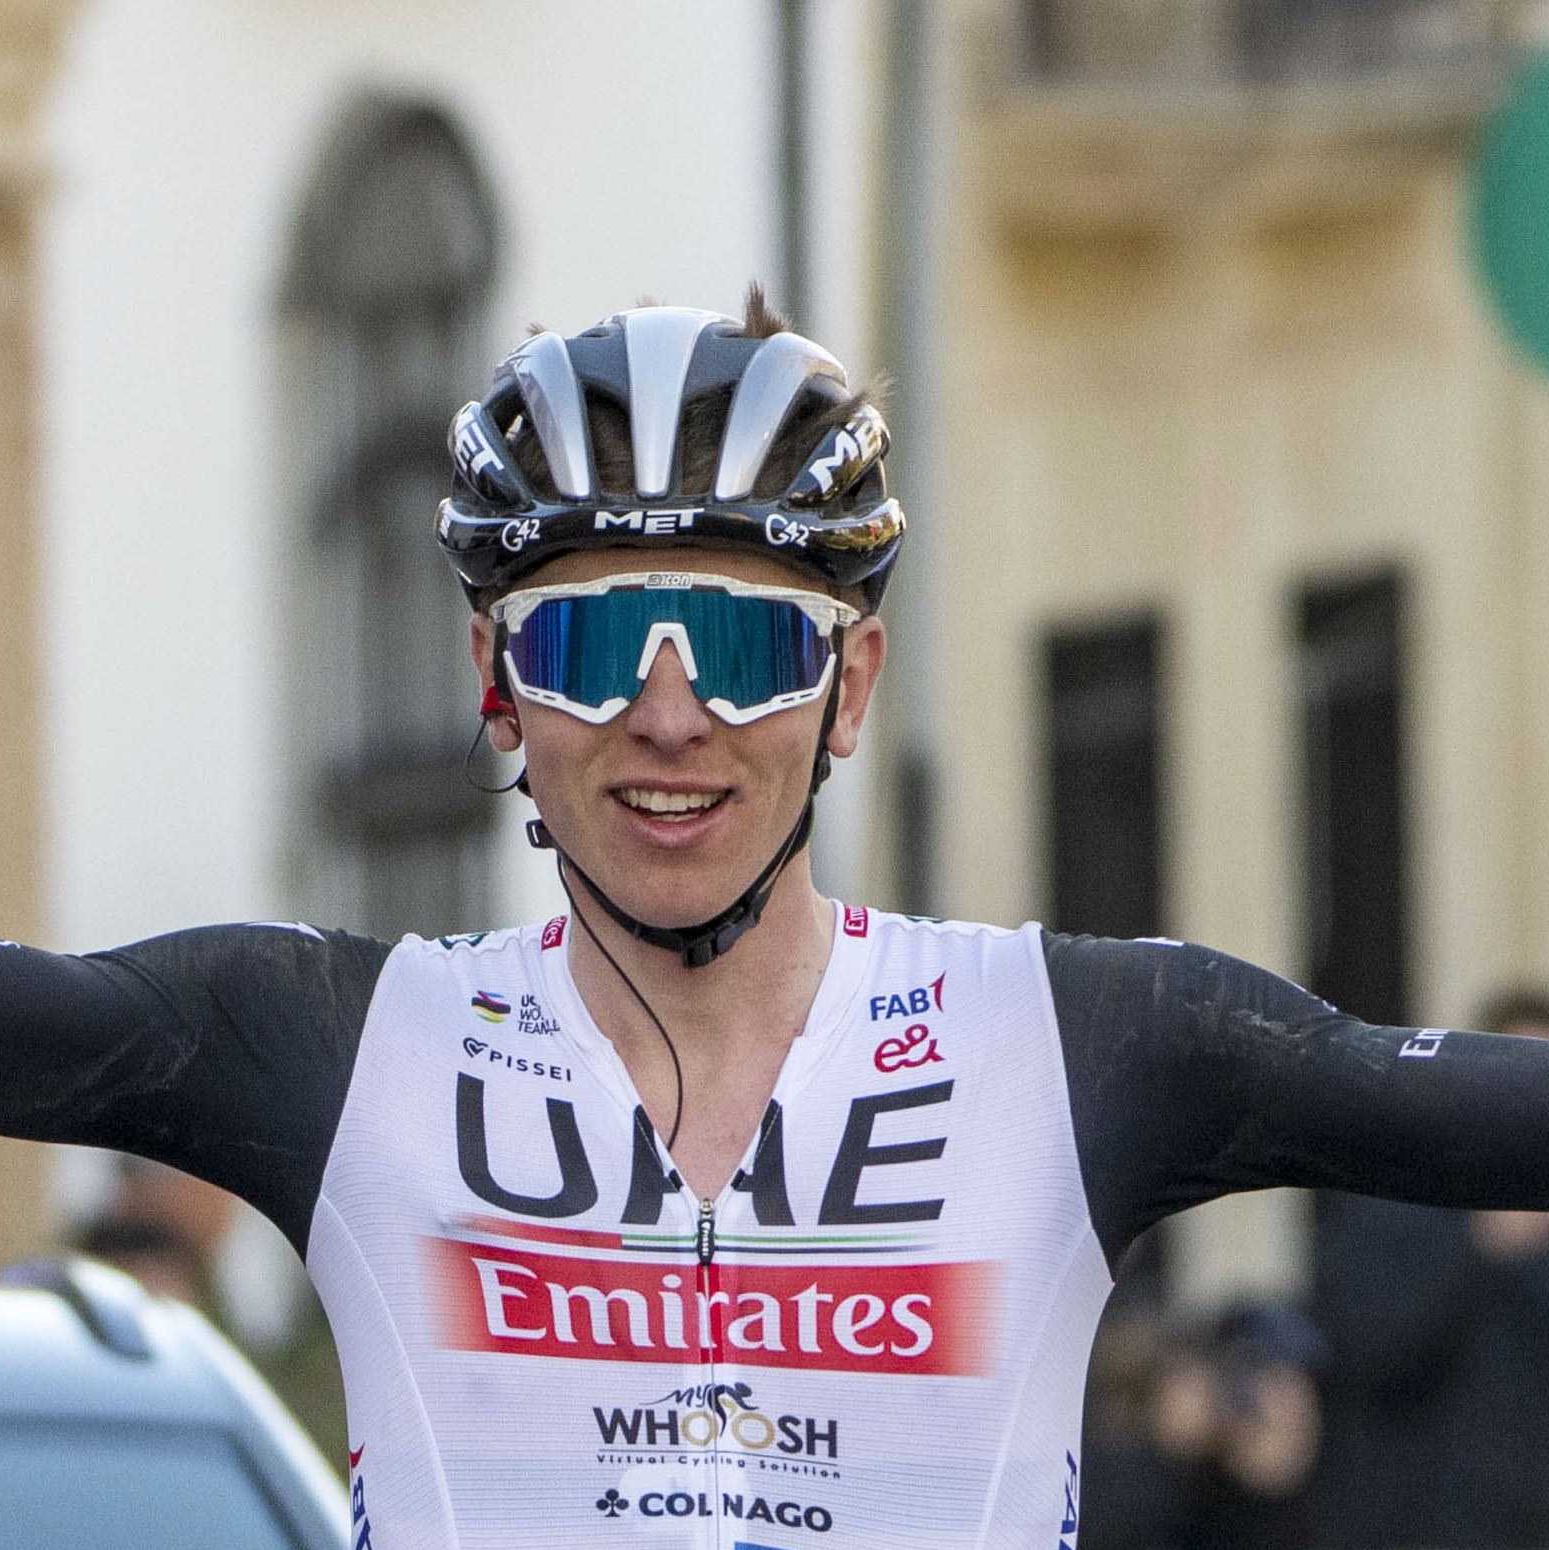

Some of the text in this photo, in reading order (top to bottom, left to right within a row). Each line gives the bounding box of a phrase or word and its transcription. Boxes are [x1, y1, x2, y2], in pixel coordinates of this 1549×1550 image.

[502, 519, 540, 553] G42
[594, 508, 705, 536] MET
[765, 513, 811, 548] G42
[870, 987, 930, 1021] FAB
[489, 1049, 572, 1082] PISSEI
[455, 1072, 956, 1227] UAE
[471, 1258, 935, 1357] Emirates
[593, 1406, 838, 1459] WHOOSH
[597, 1454, 665, 1464] Virtual
[759, 1459, 841, 1480] Solution
[638, 1492, 833, 1533] COLNAGO
